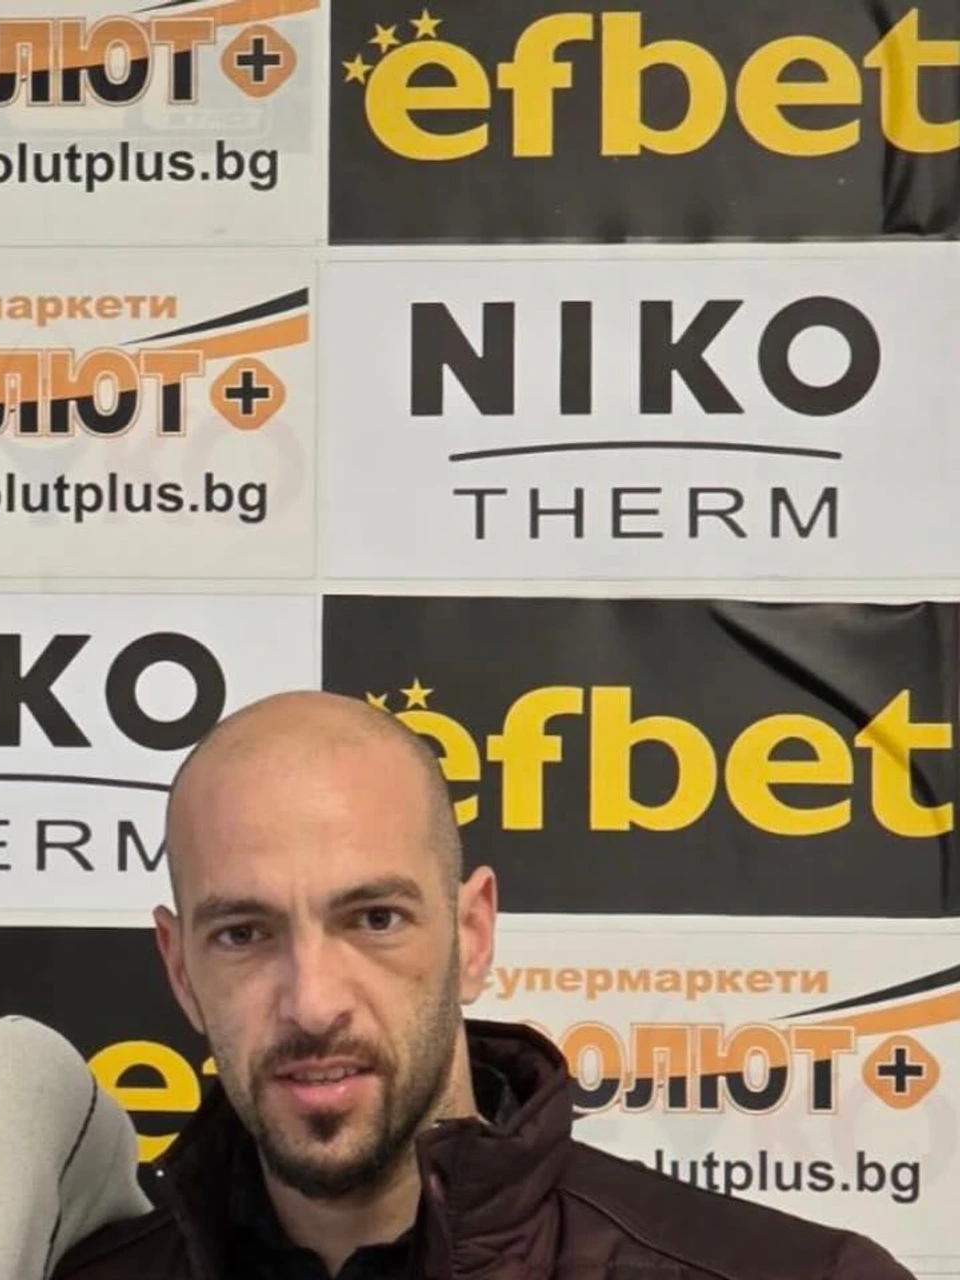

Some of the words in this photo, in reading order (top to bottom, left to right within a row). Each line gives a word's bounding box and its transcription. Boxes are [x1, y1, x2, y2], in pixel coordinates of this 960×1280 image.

[364, 8, 960, 161] efbet
[411, 296, 881, 417] NIKO
[453, 487, 837, 540] THERM
[525, 1021, 855, 1115] ОЛЮТ
